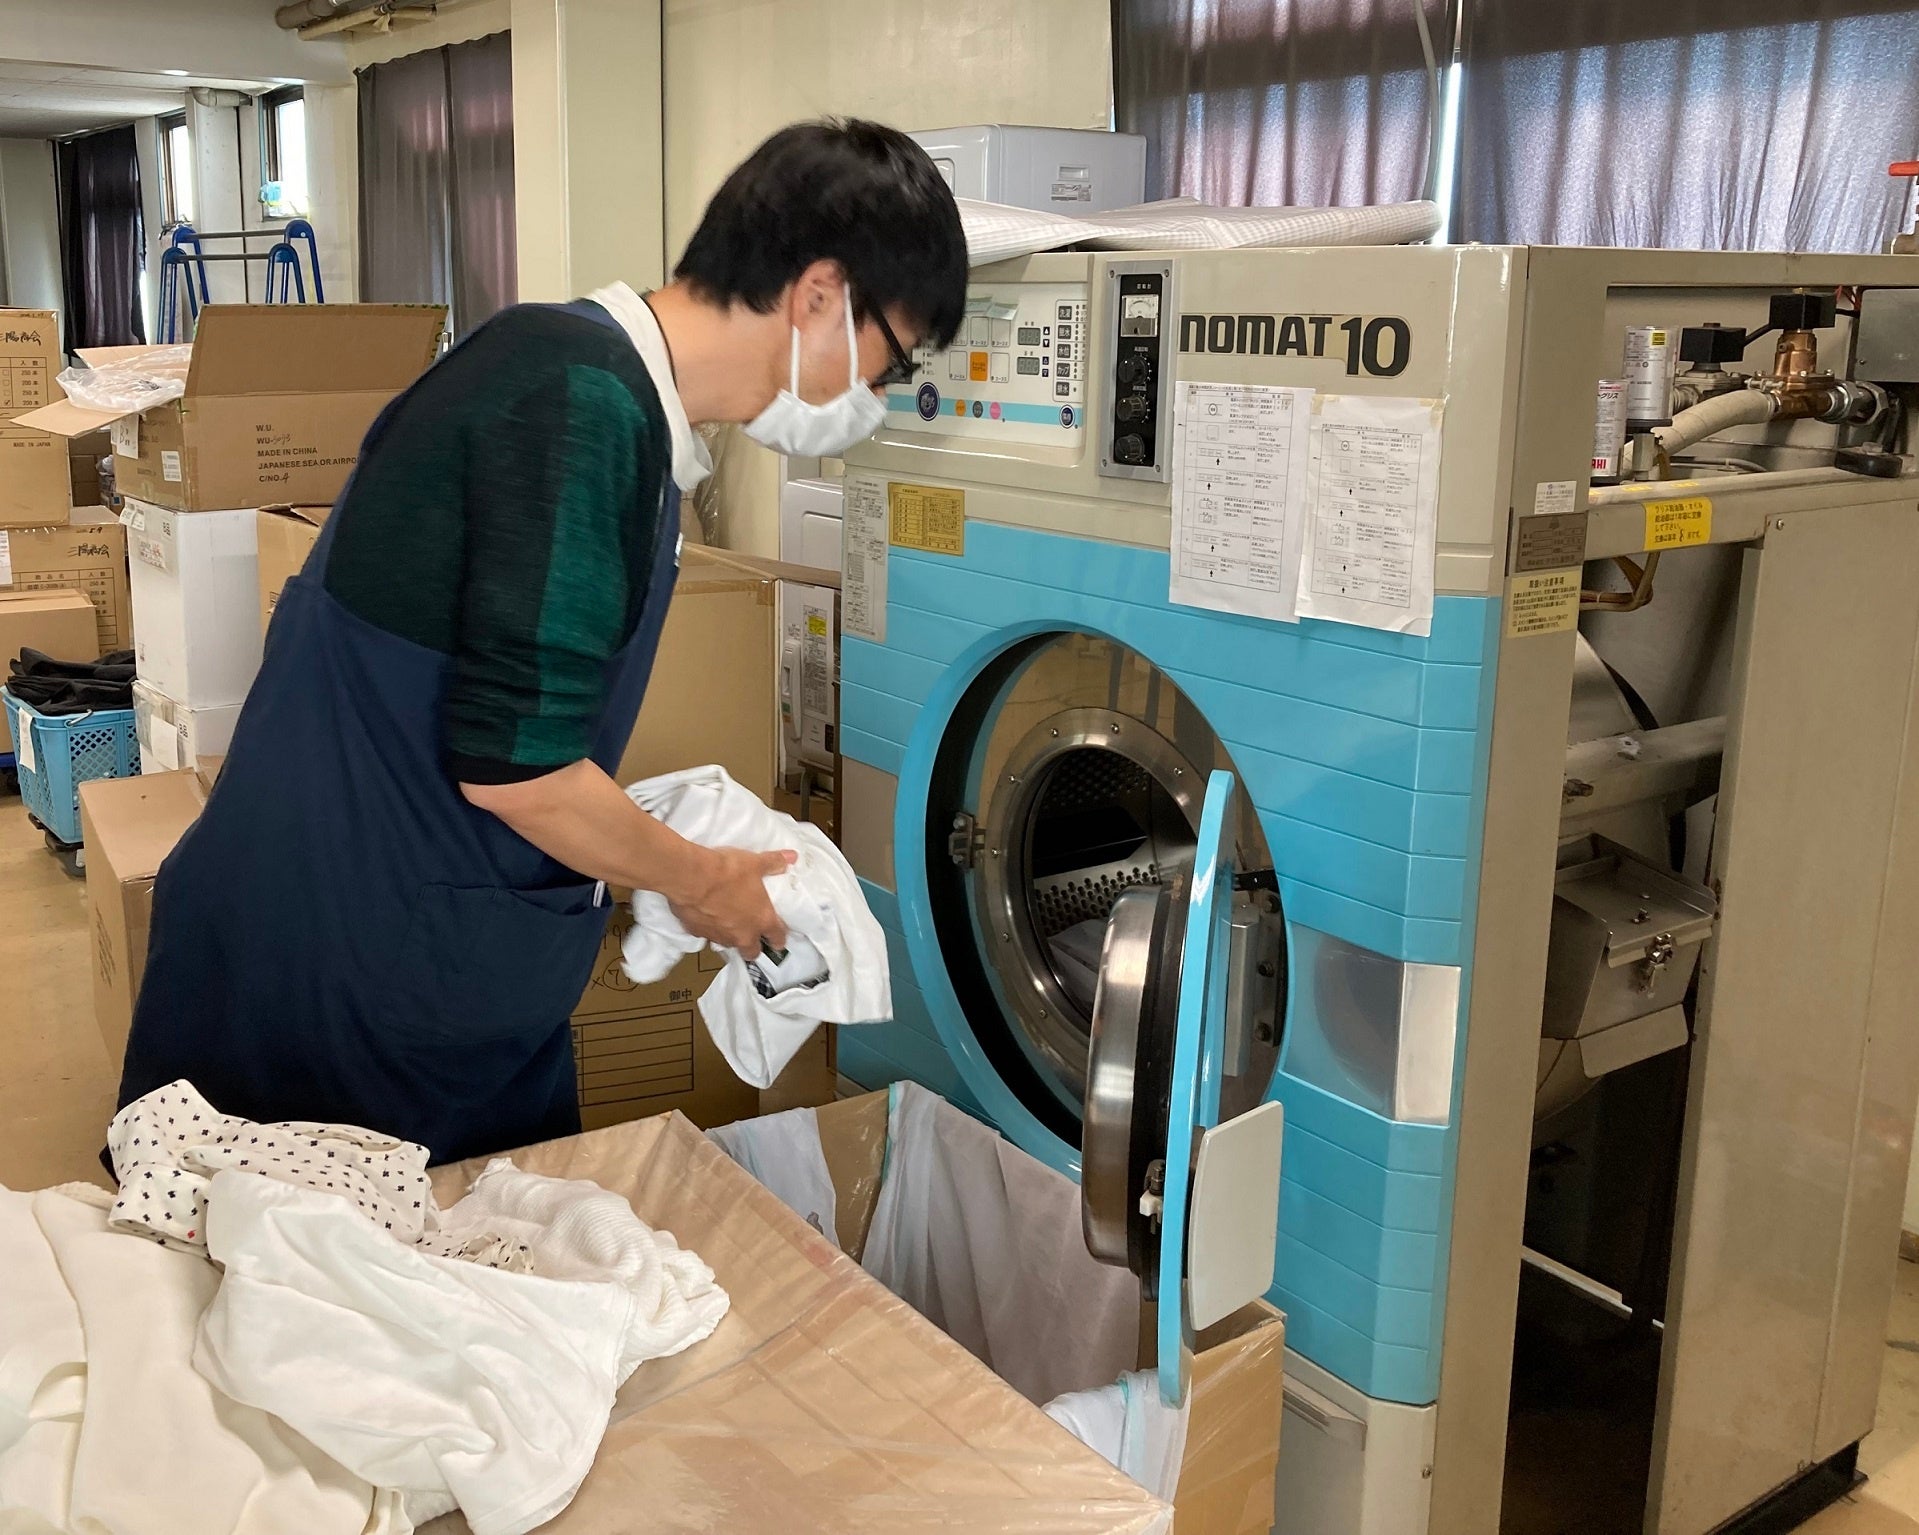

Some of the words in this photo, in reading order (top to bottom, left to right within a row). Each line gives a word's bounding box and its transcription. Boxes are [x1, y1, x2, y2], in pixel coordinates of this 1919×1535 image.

[1340, 317, 1411, 376] 10
[258, 449, 281, 457] MADE
[293, 447, 318, 455] CHINA
[259, 461, 301, 469] JAPANESE
[303, 459, 319, 467] SEA
[332, 457, 359, 465] AIRPO
